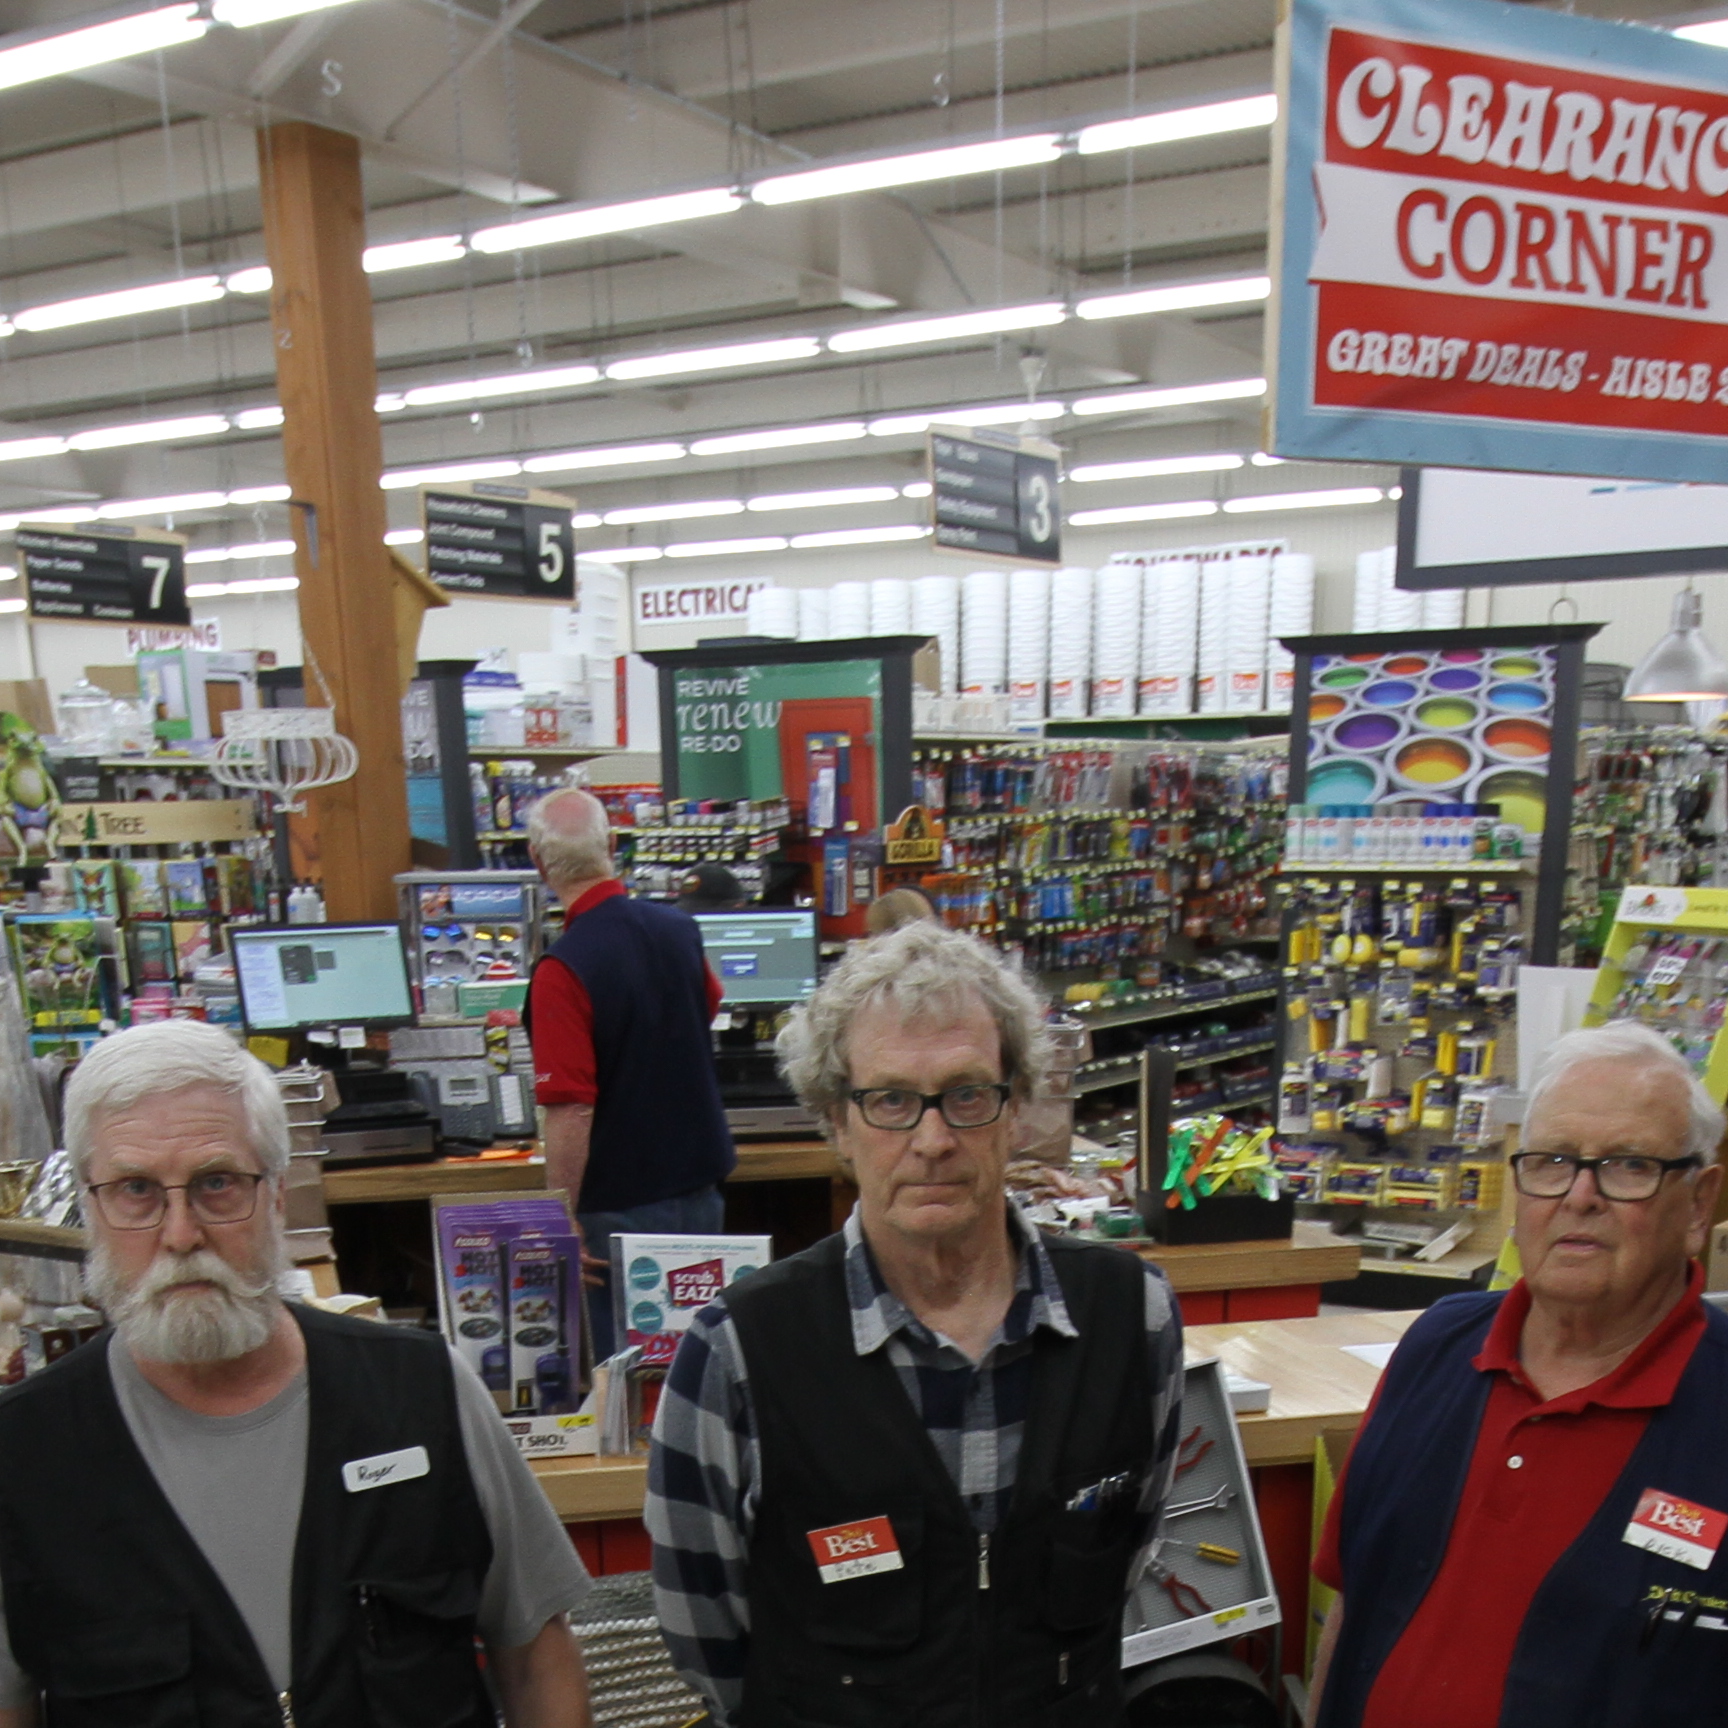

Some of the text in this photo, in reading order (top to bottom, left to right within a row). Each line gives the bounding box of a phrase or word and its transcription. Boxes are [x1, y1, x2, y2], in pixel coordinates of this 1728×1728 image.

[1396, 188, 1716, 310] CORNER
[1327, 329, 1471, 382] GREAT
[1467, 342, 1586, 393] DEALS
[1601, 357, 1713, 403] AISLE
[1029, 475, 1051, 543] 3
[538, 523, 564, 583] 5
[31, 579, 72, 594] Batteries
[141, 556, 170, 609] 7
[641, 583, 765, 620] ELECTRIC
[677, 676, 750, 697] REVIVE
[676, 701, 783, 731] renew
[101, 812, 145, 834] TREE
[674, 1270, 715, 1285] scrub
[357, 1464, 398, 1483] Roger
[1649, 1501, 1706, 1537] Best
[823, 1531, 879, 1558] Best
